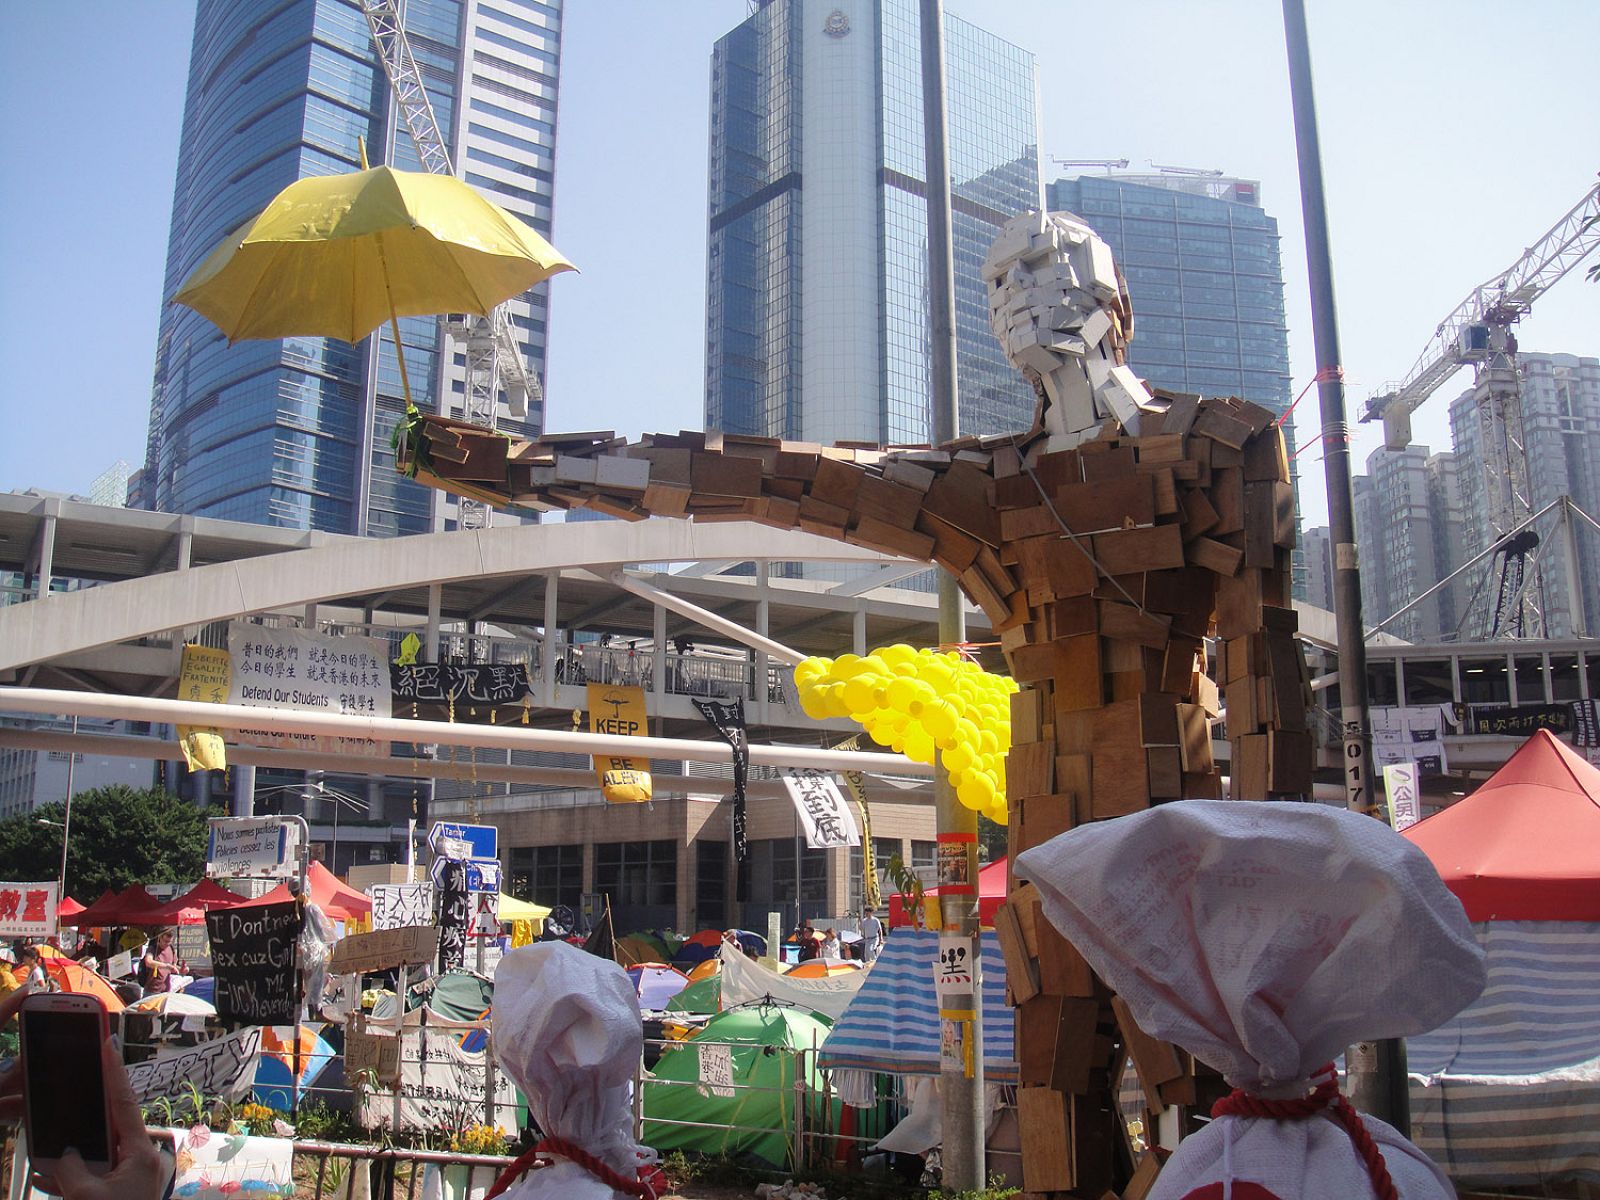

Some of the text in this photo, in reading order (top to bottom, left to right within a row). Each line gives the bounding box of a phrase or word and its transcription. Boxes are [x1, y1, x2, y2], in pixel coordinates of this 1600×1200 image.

[242, 641, 380, 670] 昔日的我們 就是今日的學生
[240, 661, 296, 679] 今日的學生
[394, 665, 528, 700] 絕沉默
[242, 685, 272, 701] Defend
[274, 689, 290, 703] Our
[292, 690, 329, 708] Students
[596, 719, 639, 736] KEEP
[609, 758, 634, 770] BE
[1346, 721, 1362, 802] 5017
[218, 826, 234, 841] Nous
[0, 889, 48, 922] 教室
[210, 915, 224, 943] I
